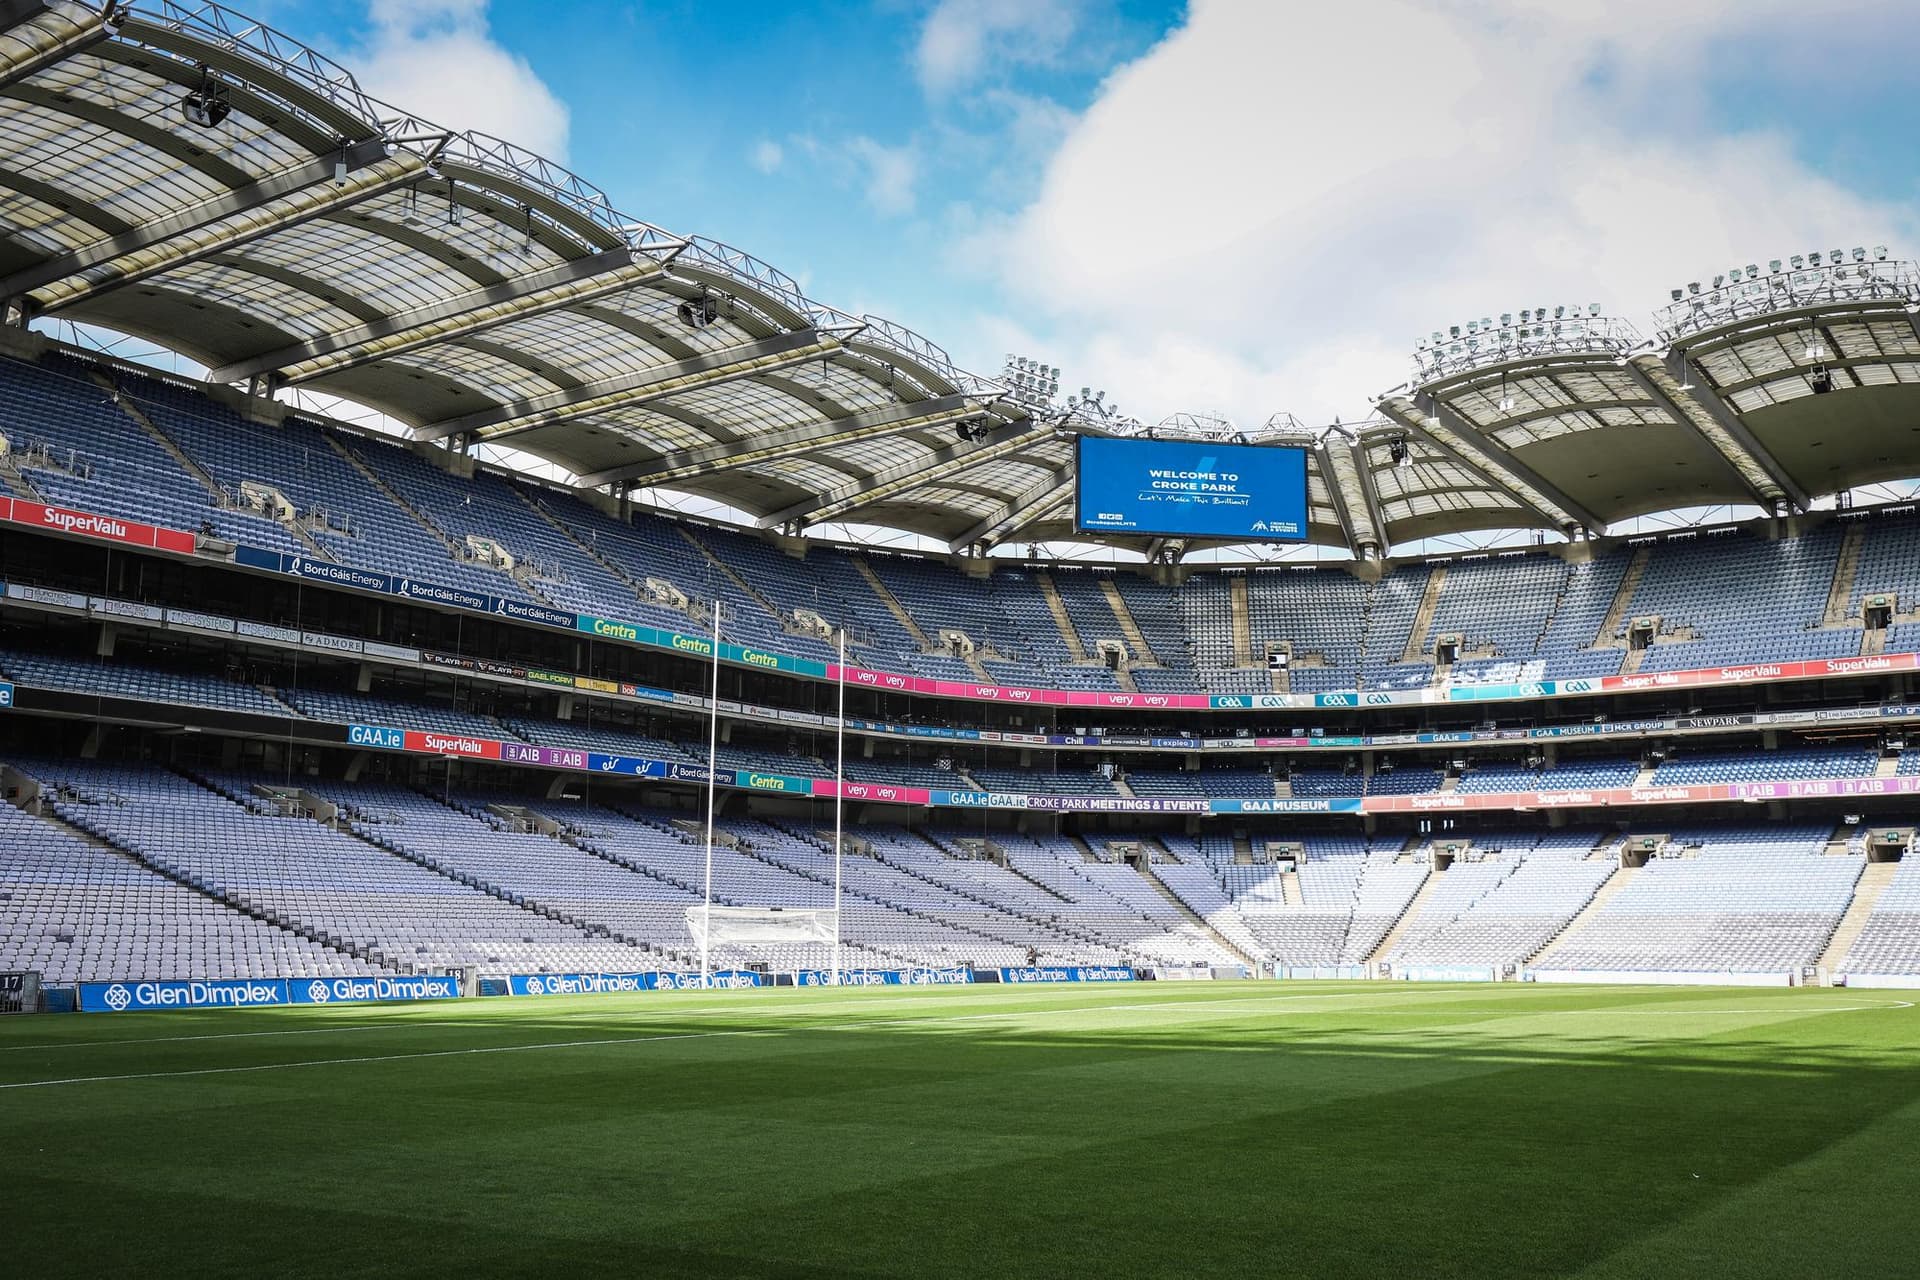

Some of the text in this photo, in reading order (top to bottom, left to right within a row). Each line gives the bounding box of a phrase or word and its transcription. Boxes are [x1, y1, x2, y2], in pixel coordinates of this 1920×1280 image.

[1149, 469, 1239, 482] WELCOME TO
[1152, 481, 1237, 492] CROKE PARK
[44, 507, 127, 537] SuperValu
[304, 562, 385, 589] Bord Gáis Energy
[412, 584, 484, 608] Bord Gáis Energy
[508, 603, 572, 626] Bord Gáis Energy
[594, 619, 637, 640] Centra
[316, 636, 361, 651] ADMORE
[672, 634, 711, 654] Centra
[435, 656, 474, 668] PLAYR-FIT
[742, 649, 778, 667] Centra
[1827, 656, 1891, 673] SuperValu
[488, 665, 526, 677] PLAYR-FIT
[1720, 665, 1781, 680] SuperValu
[550, 673, 573, 684] FORM
[857, 670, 906, 689] very very
[1622, 673, 1678, 688] SuperValu
[622, 684, 636, 696] bob
[976, 686, 1032, 701] very very
[1565, 681, 1592, 693] GAA
[1109, 694, 1169, 706] very very
[1218, 696, 1244, 707] GAA
[1323, 694, 1350, 706] GAA
[1366, 693, 1392, 705] GAA
[1634, 722, 1663, 730] GROUP
[1690, 716, 1740, 728] NEWPARK
[351, 726, 400, 747] GAA.ie
[1432, 733, 1460, 742] GAA.ie
[1536, 726, 1595, 737] GAA MUSEUM
[425, 735, 482, 754] SuperValu
[1065, 736, 1084, 745] Chill
[519, 748, 540, 762] AIB
[562, 752, 582, 766] AIB
[603, 757, 620, 771] eir
[636, 759, 652, 774] eir
[680, 767, 696, 777] Bord
[749, 774, 784, 790] Centra
[1858, 780, 1884, 793] AIB
[847, 784, 897, 799] very very
[1631, 787, 1689, 802] SuperValu
[1750, 784, 1775, 797] AIB
[1803, 783, 1829, 795] AIB
[951, 792, 988, 805] GAA.ie
[990, 794, 1026, 807] GAA.ie
[1027, 797, 1210, 810] CROKE PARK MEETINGS & EVENTS
[1412, 796, 1464, 808] SuperValu
[1537, 792, 1592, 805] SuperValu
[1243, 801, 1329, 811] GAA MUSEUM
[449, 970, 461, 980] 18
[1018, 969, 1069, 982] GlenDimplex
[1086, 969, 1130, 981] GlenDimplex
[4, 976, 19, 989] 17
[546, 975, 640, 994] GlenDimplex
[136, 982, 279, 1007] GlenDimplex
[333, 979, 450, 1001] GlenDimplex
